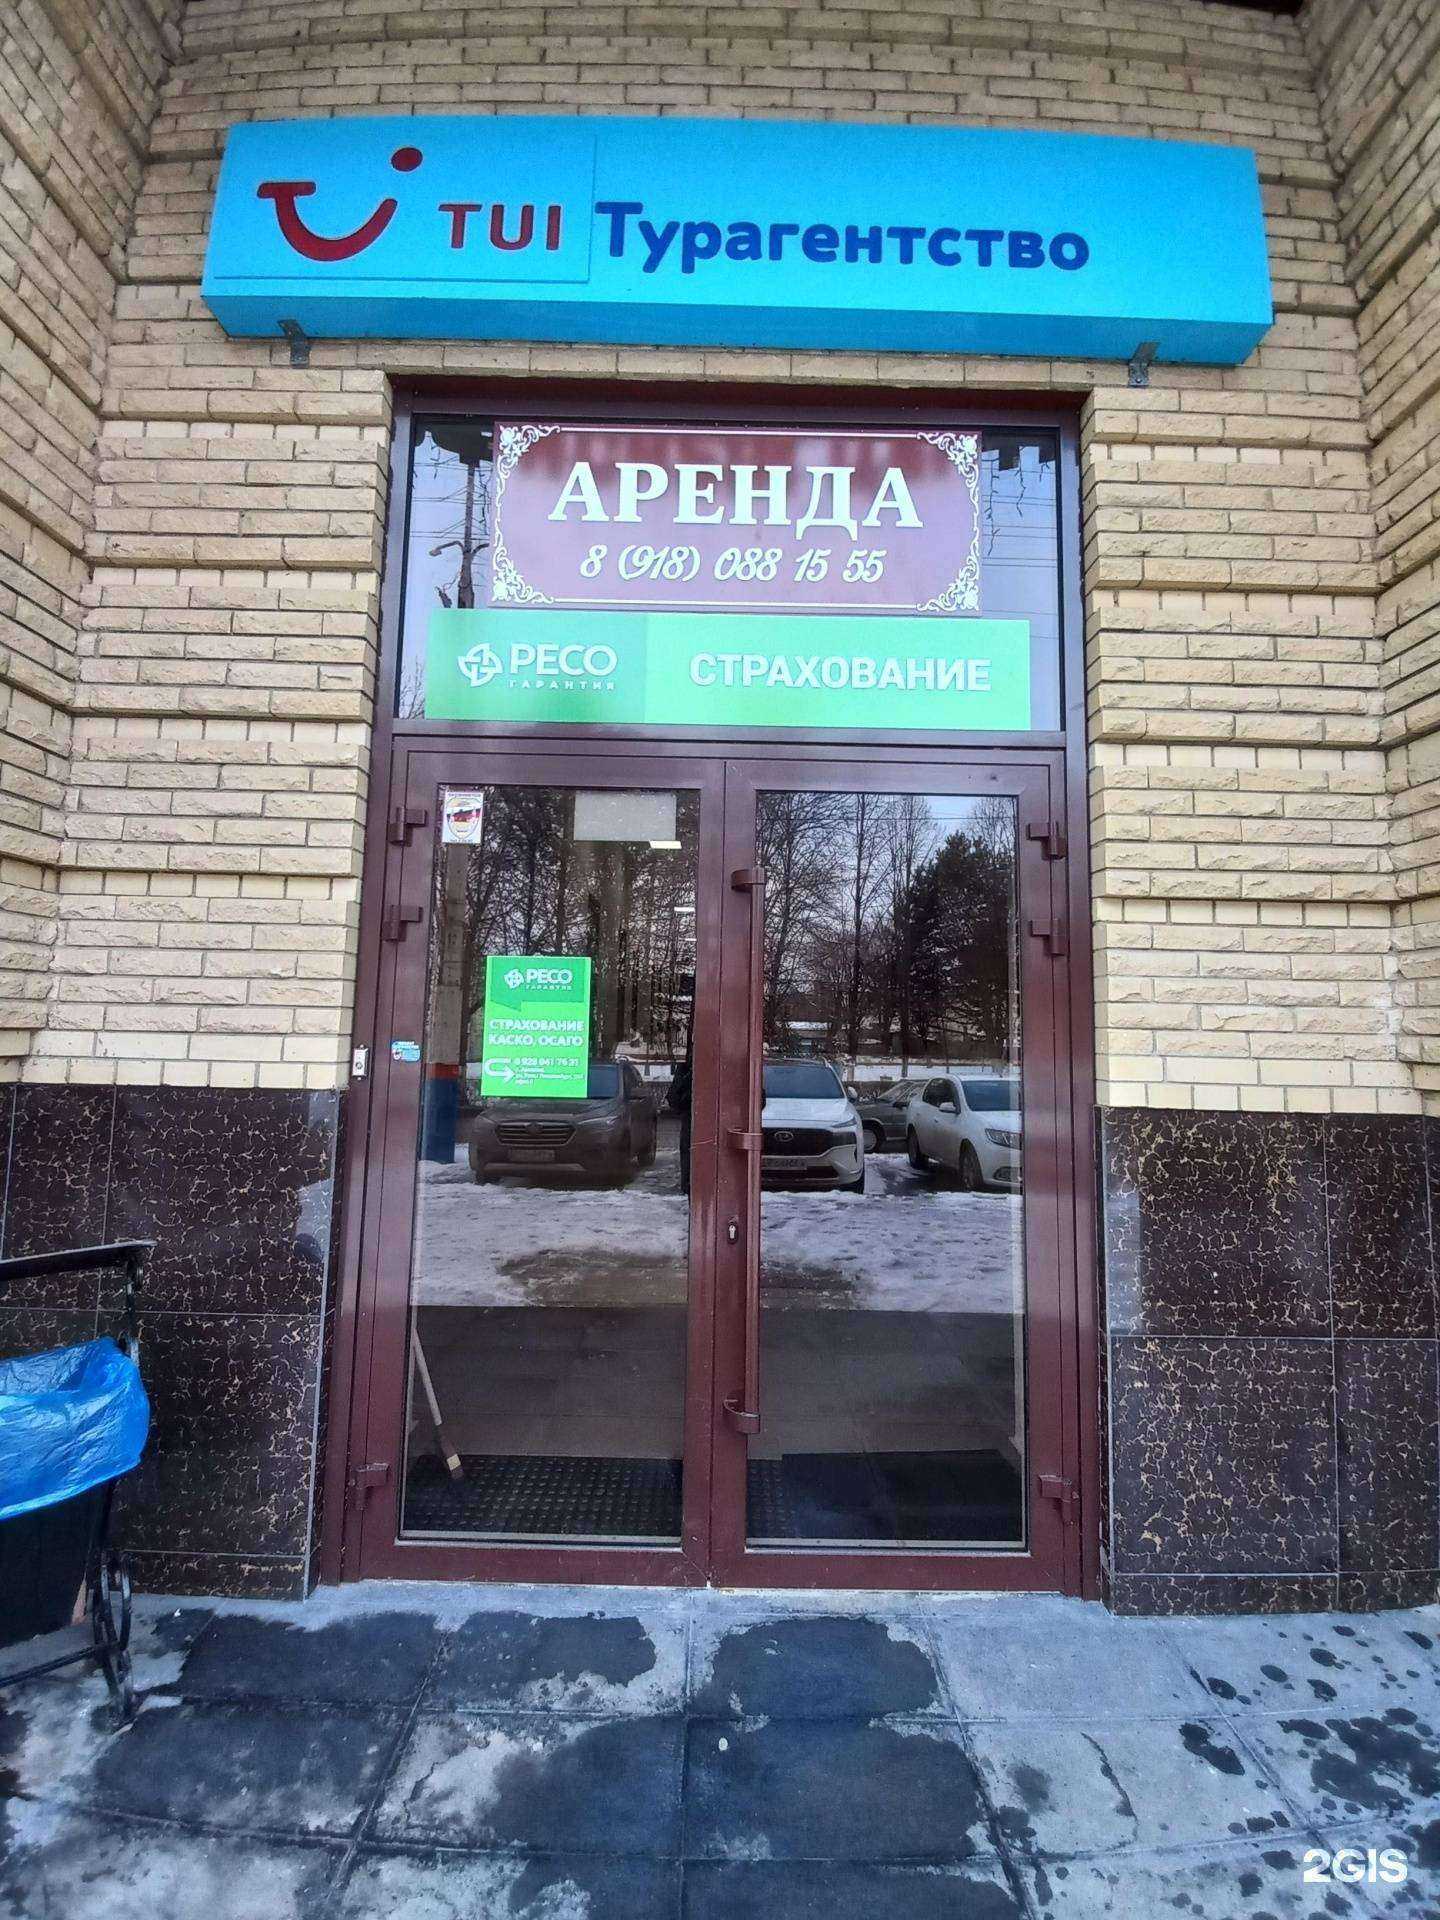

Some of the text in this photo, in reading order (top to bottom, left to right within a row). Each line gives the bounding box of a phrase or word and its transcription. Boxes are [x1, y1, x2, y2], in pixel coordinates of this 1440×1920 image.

[438, 204, 561, 250] TUI
[594, 201, 1090, 274] Турагентство
[547, 460, 924, 541] АРЕНДА
[580, 544, 887, 584] 8 (918) 088 15 55
[510, 642, 618, 677] РЕСО
[689, 652, 991, 692] СТРАХОВАНИЕ
[509, 680, 615, 690] ГАРАНТИЯ
[526, 968, 573, 984] РЕСО
[488, 1033, 583, 1047] КАСКО ОСАГО
[489, 1019, 585, 1032] СТРАХОВАНИЕ
